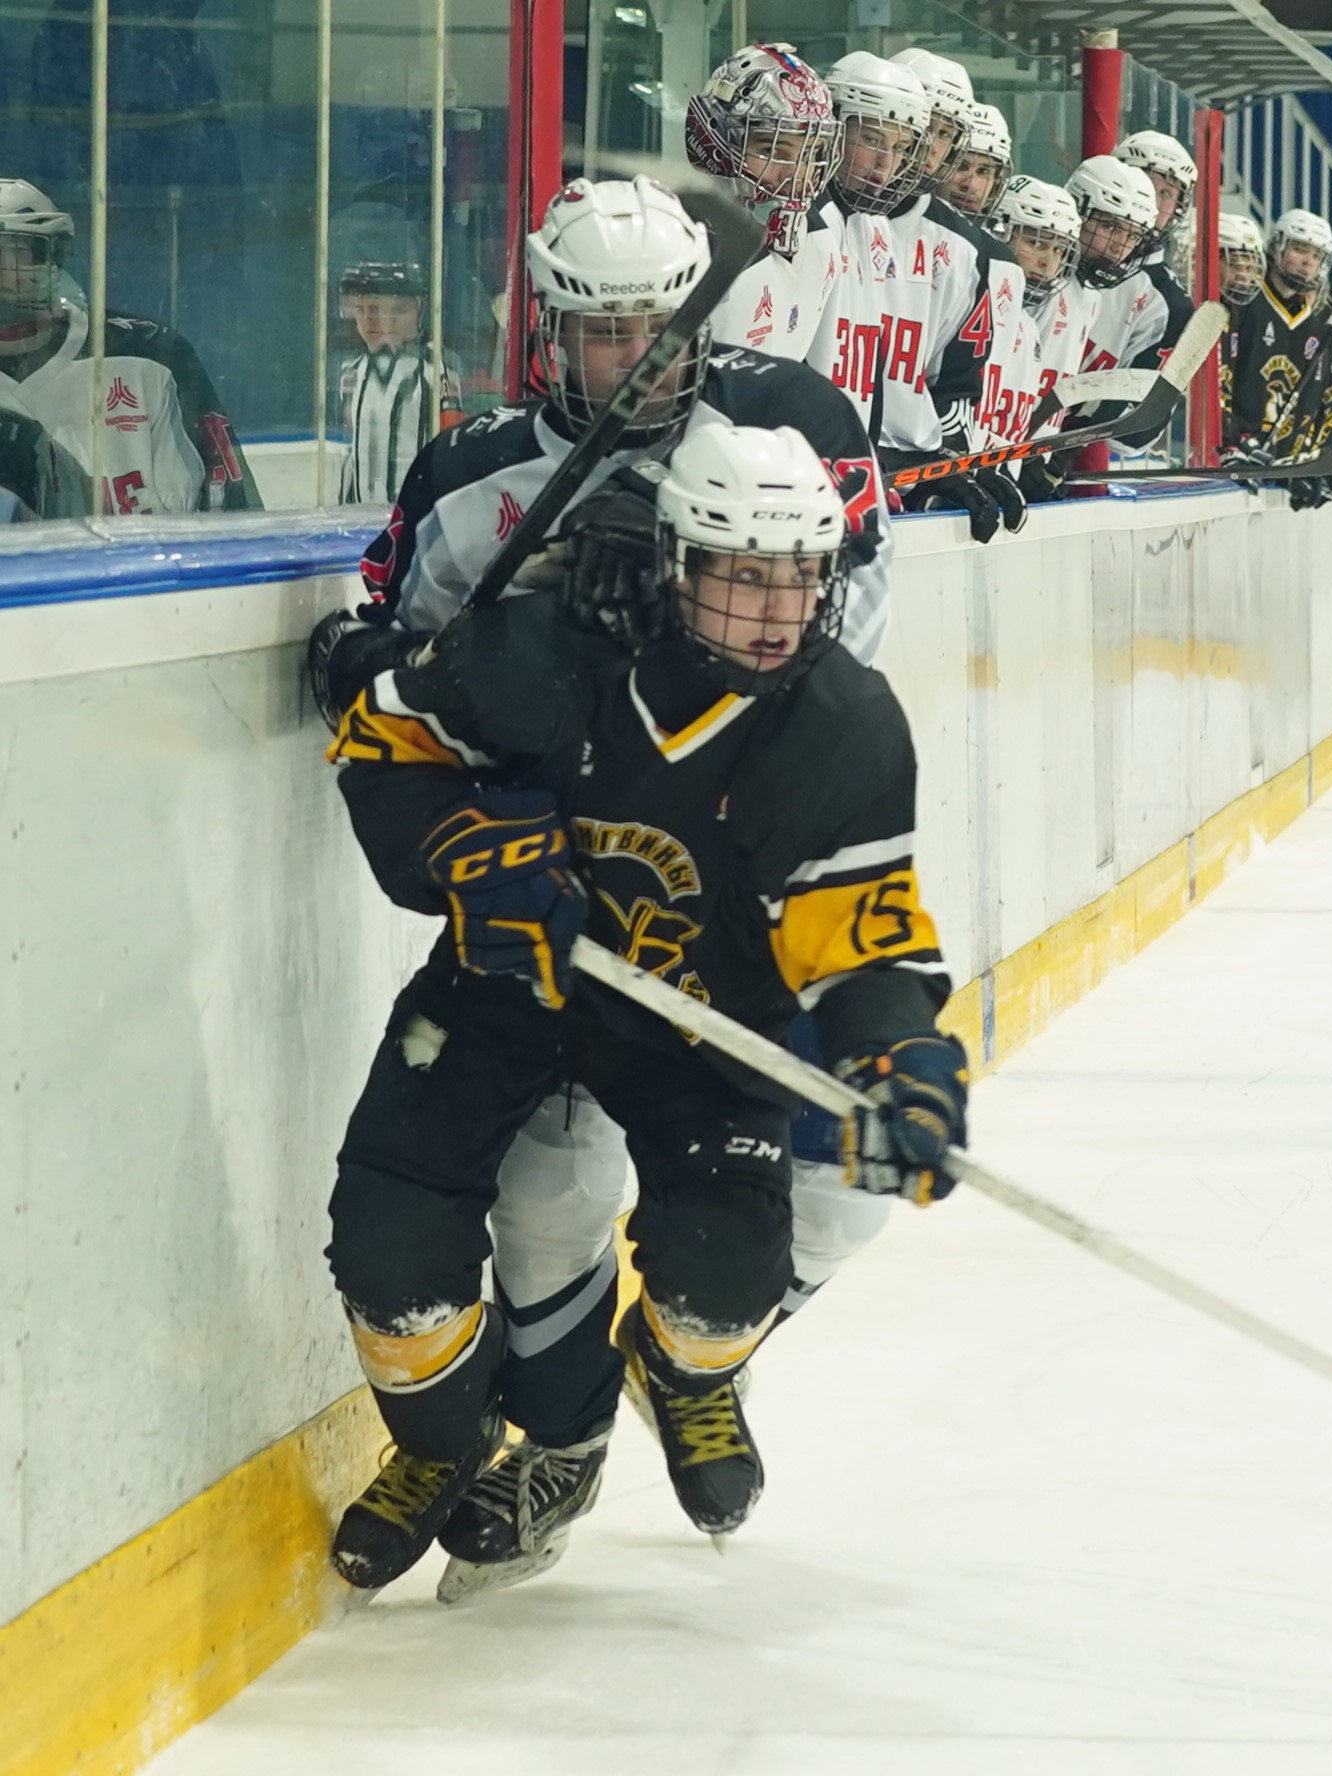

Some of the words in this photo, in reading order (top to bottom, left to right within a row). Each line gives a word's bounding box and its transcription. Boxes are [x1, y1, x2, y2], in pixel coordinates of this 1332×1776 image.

[936, 88, 966, 103] CCM
[911, 238, 926, 276] A
[599, 281, 656, 296] Reebok
[893, 441, 1035, 487] SOYUZ
[752, 510, 804, 520] CCM
[850, 879, 914, 955] 15
